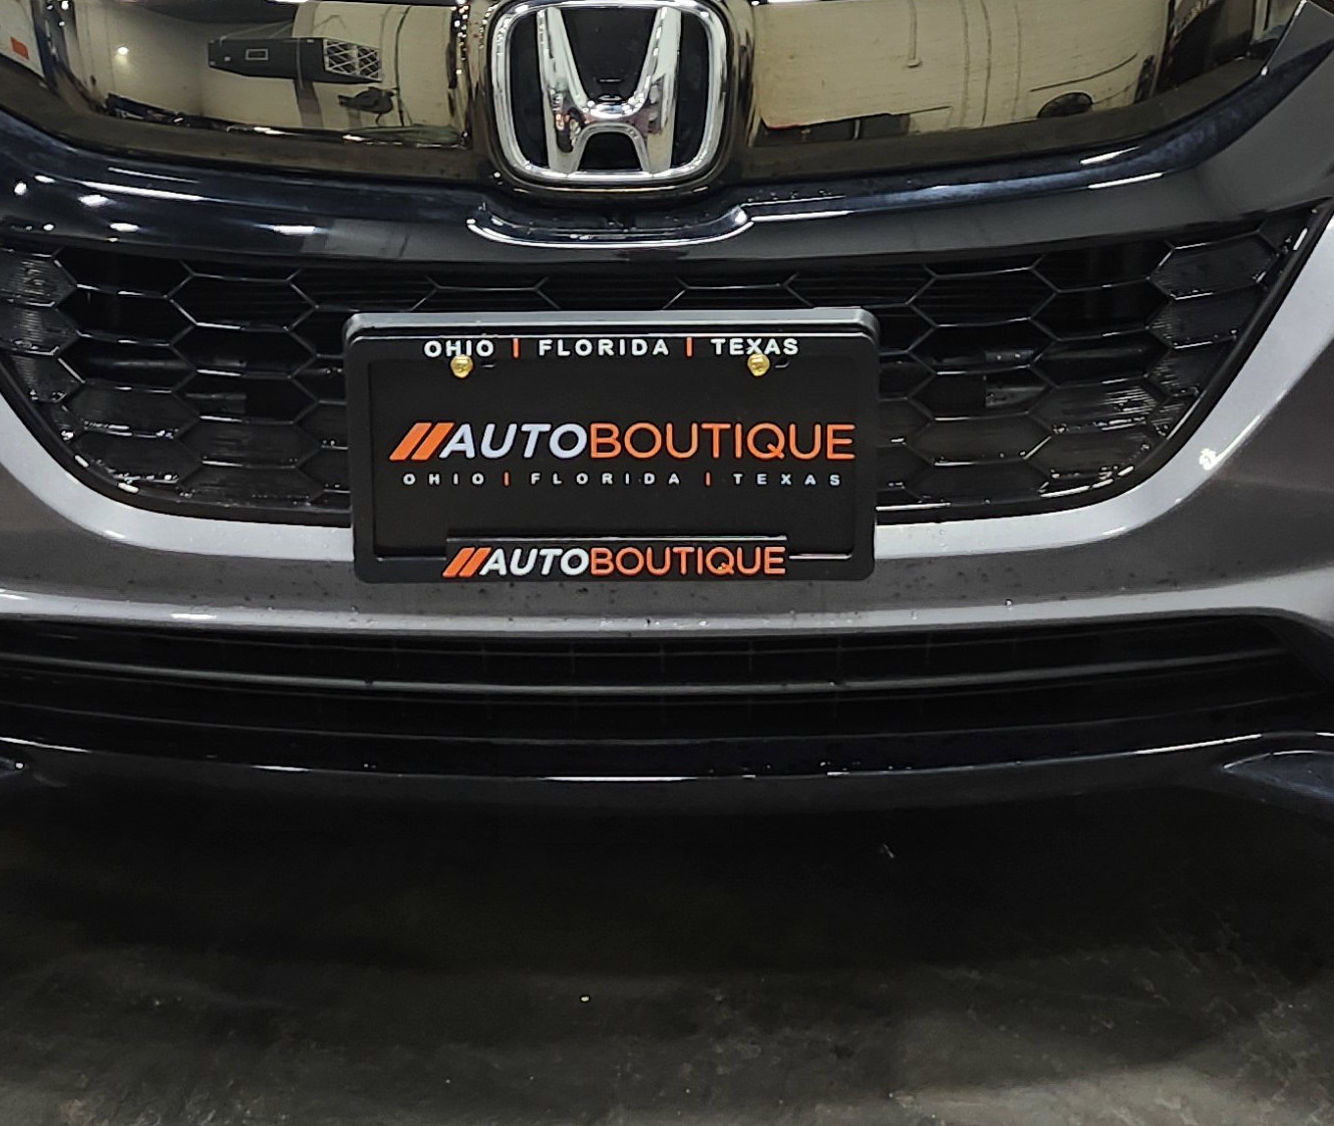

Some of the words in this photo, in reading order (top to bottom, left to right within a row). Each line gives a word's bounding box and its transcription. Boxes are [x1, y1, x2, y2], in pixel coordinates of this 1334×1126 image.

[423, 338, 495, 358] OHIO
[538, 338, 669, 357] FLORIDA
[710, 337, 799, 356] TEXAS
[438, 422, 857, 461] AUTOBOUTIQUE
[402, 472, 486, 486] OHIO
[530, 472, 681, 486] FLORIDA
[733, 473, 841, 487] TEXAS
[478, 545, 786, 576] AUTOBOUTIQUE
